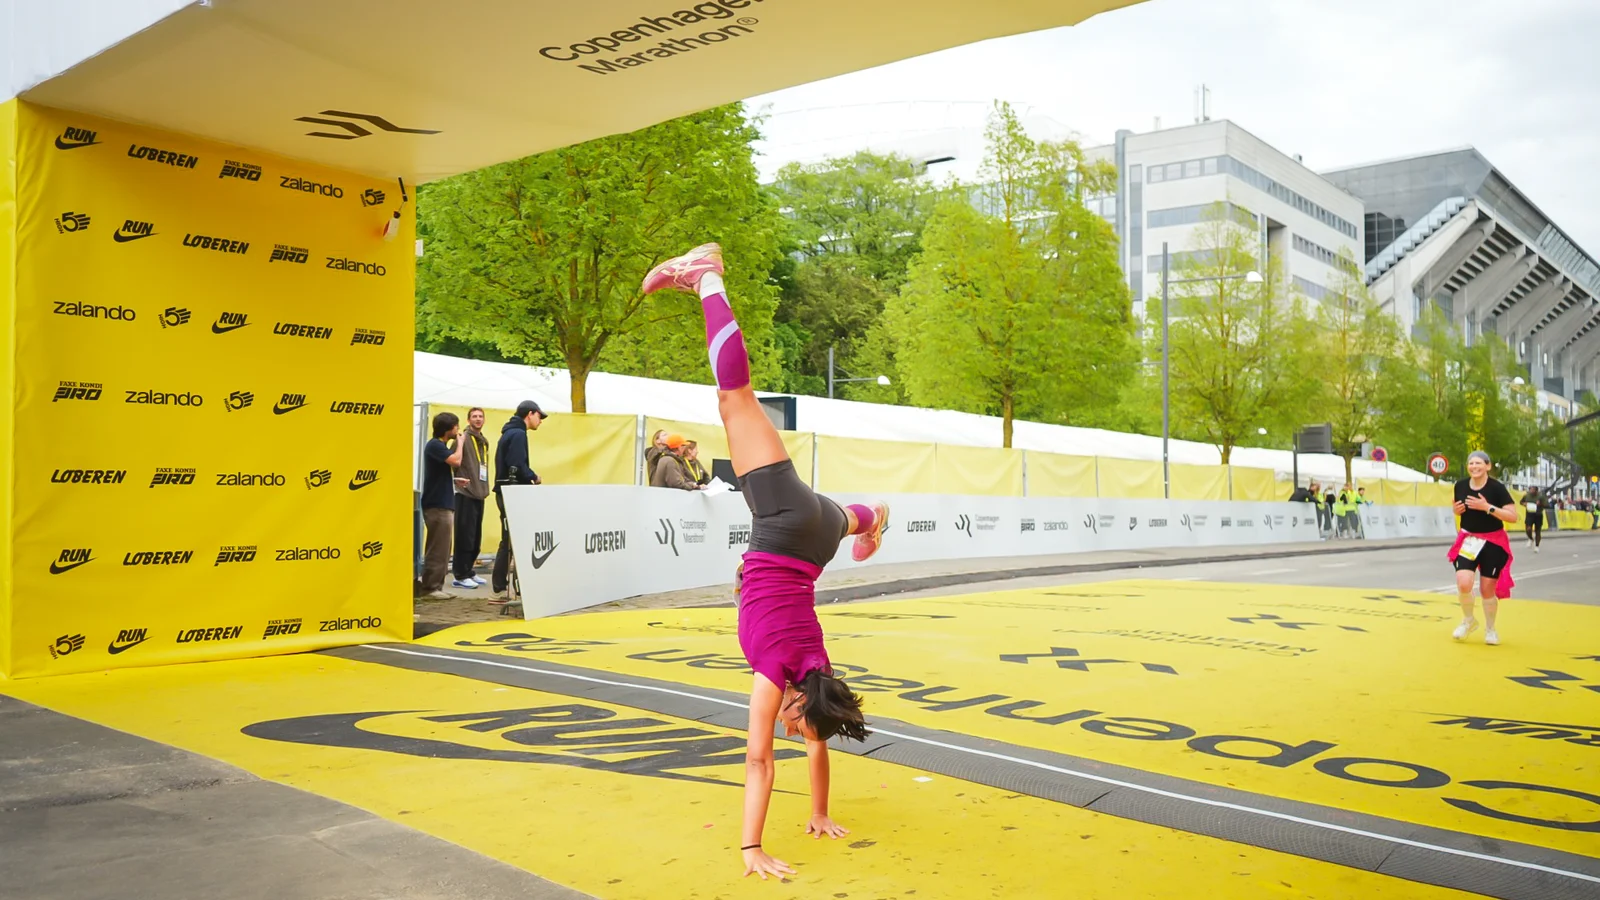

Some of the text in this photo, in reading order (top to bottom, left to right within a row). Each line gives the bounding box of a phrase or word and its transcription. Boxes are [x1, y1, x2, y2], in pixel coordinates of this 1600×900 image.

[538, 0, 763, 61] Copenhage
[63, 126, 97, 143] RUN
[279, 176, 344, 199] zalando
[122, 220, 154, 235] RUN
[326, 257, 386, 277] zalando
[53, 301, 136, 321] zalando
[219, 312, 247, 326] RUN
[125, 389, 203, 407] zalando
[280, 393, 306, 406] RUN
[216, 472, 286, 486] zalando
[355, 470, 378, 481] RUN
[534, 530, 554, 552] RUN
[58, 548, 92, 562] RUN
[275, 546, 341, 561] zalando
[319, 616, 382, 632] zalando
[116, 628, 147, 643] RUN
[419, 704, 807, 775] RUN
[625, 648, 1600, 833] Copenhaen
